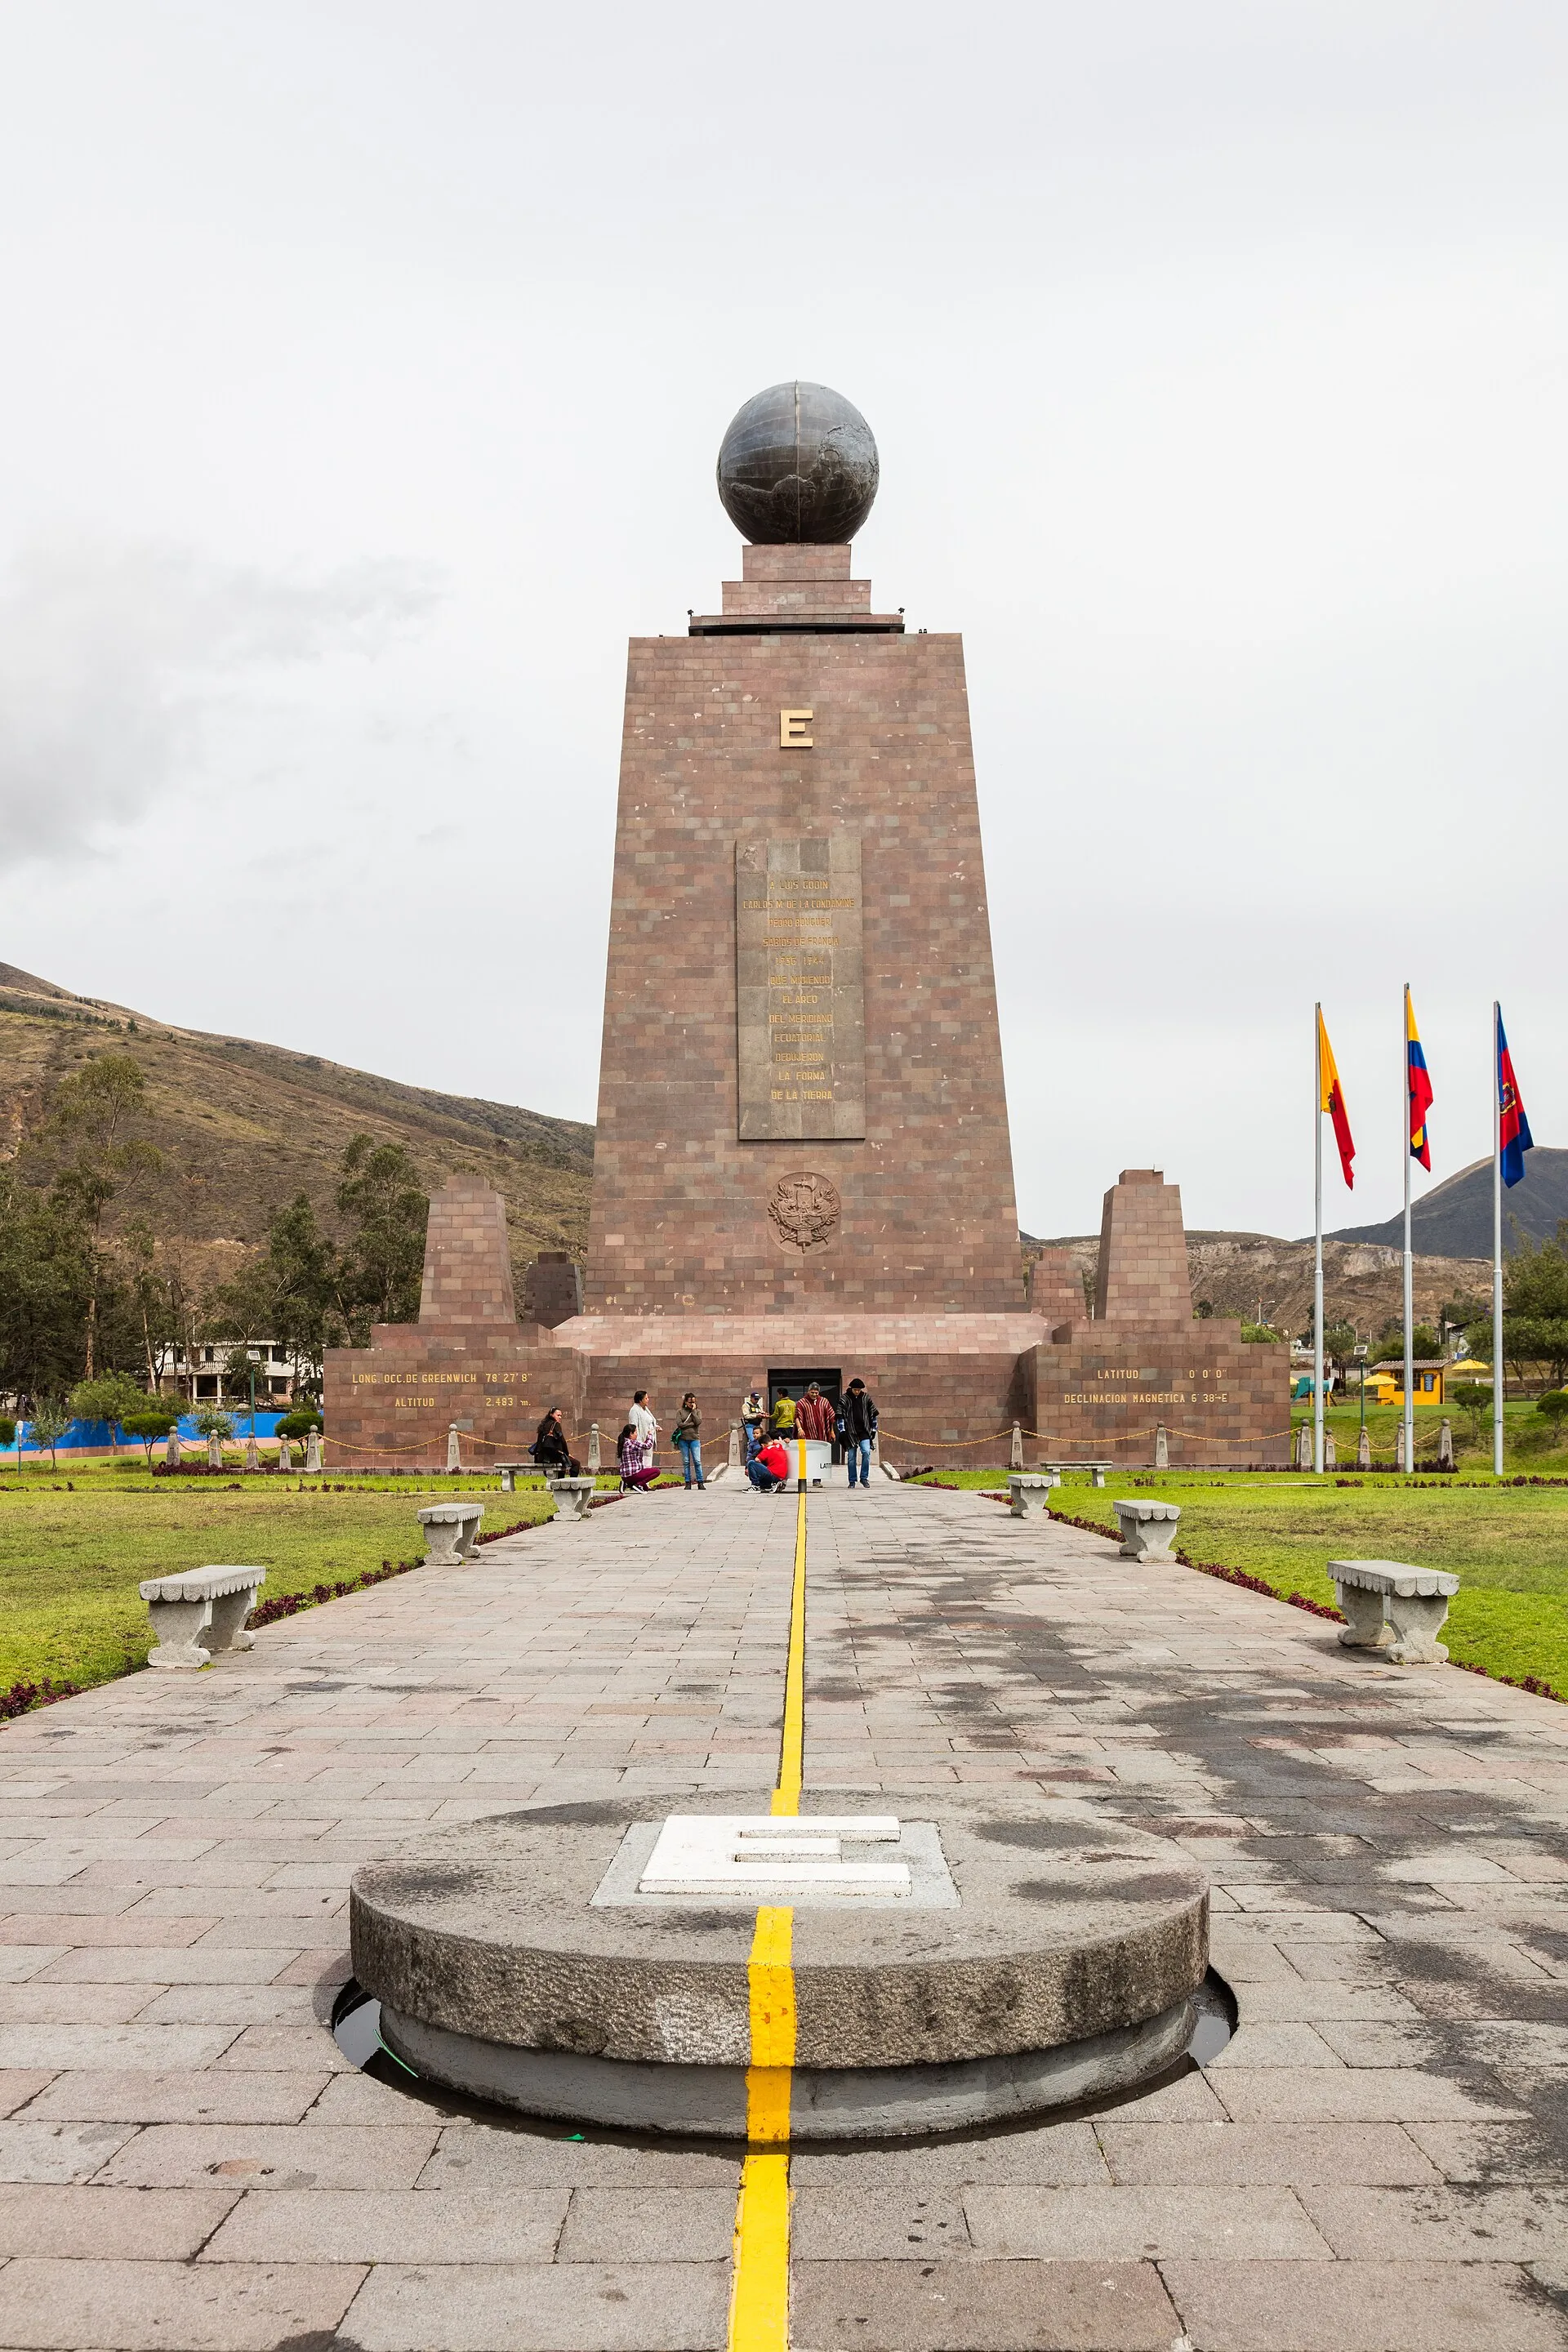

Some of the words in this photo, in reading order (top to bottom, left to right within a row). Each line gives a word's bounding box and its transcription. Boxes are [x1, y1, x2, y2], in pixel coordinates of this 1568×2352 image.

[780, 709, 813, 748] E
[769, 880, 775, 889] A
[779, 880, 800, 889] LUIS
[803, 880, 830, 889] GODIN
[743, 900, 773, 909] CARLOS
[786, 899, 797, 909] DE
[800, 899, 809, 908] LA
[811, 898, 855, 908] CONDAMINE
[768, 918, 793, 928] PEDRO
[762, 937, 792, 947] SABIOS
[794, 937, 806, 947] DE
[808, 936, 840, 947] FRANCIA
[770, 975, 787, 986] QUE
[791, 975, 831, 985] MIDIENDO
[782, 994, 793, 1004] EL
[795, 994, 817, 1004] ARCO
[769, 1013, 786, 1023] DEL
[788, 1013, 833, 1023] MERIDIANO
[774, 1033, 826, 1042] ECUATORIAL
[775, 1053, 824, 1062] DEDUJERON
[778, 1071, 790, 1080] LA
[796, 1071, 826, 1080] FORMA
[771, 1090, 783, 1100] DE
[786, 1089, 798, 1100] LA
[803, 1090, 833, 1100] TIERRA
[352, 1374, 381, 1383] LONG.
[421, 1373, 477, 1383] GREENWICH
[1098, 1370, 1139, 1379] LATITUD
[394, 1397, 435, 1407] ALTITUD
[485, 1397, 514, 1406] 2.483
[1064, 1393, 1127, 1403] DECLINACION
[1133, 1393, 1186, 1403] MAGNETICA
[636, 1813, 913, 1897] E
